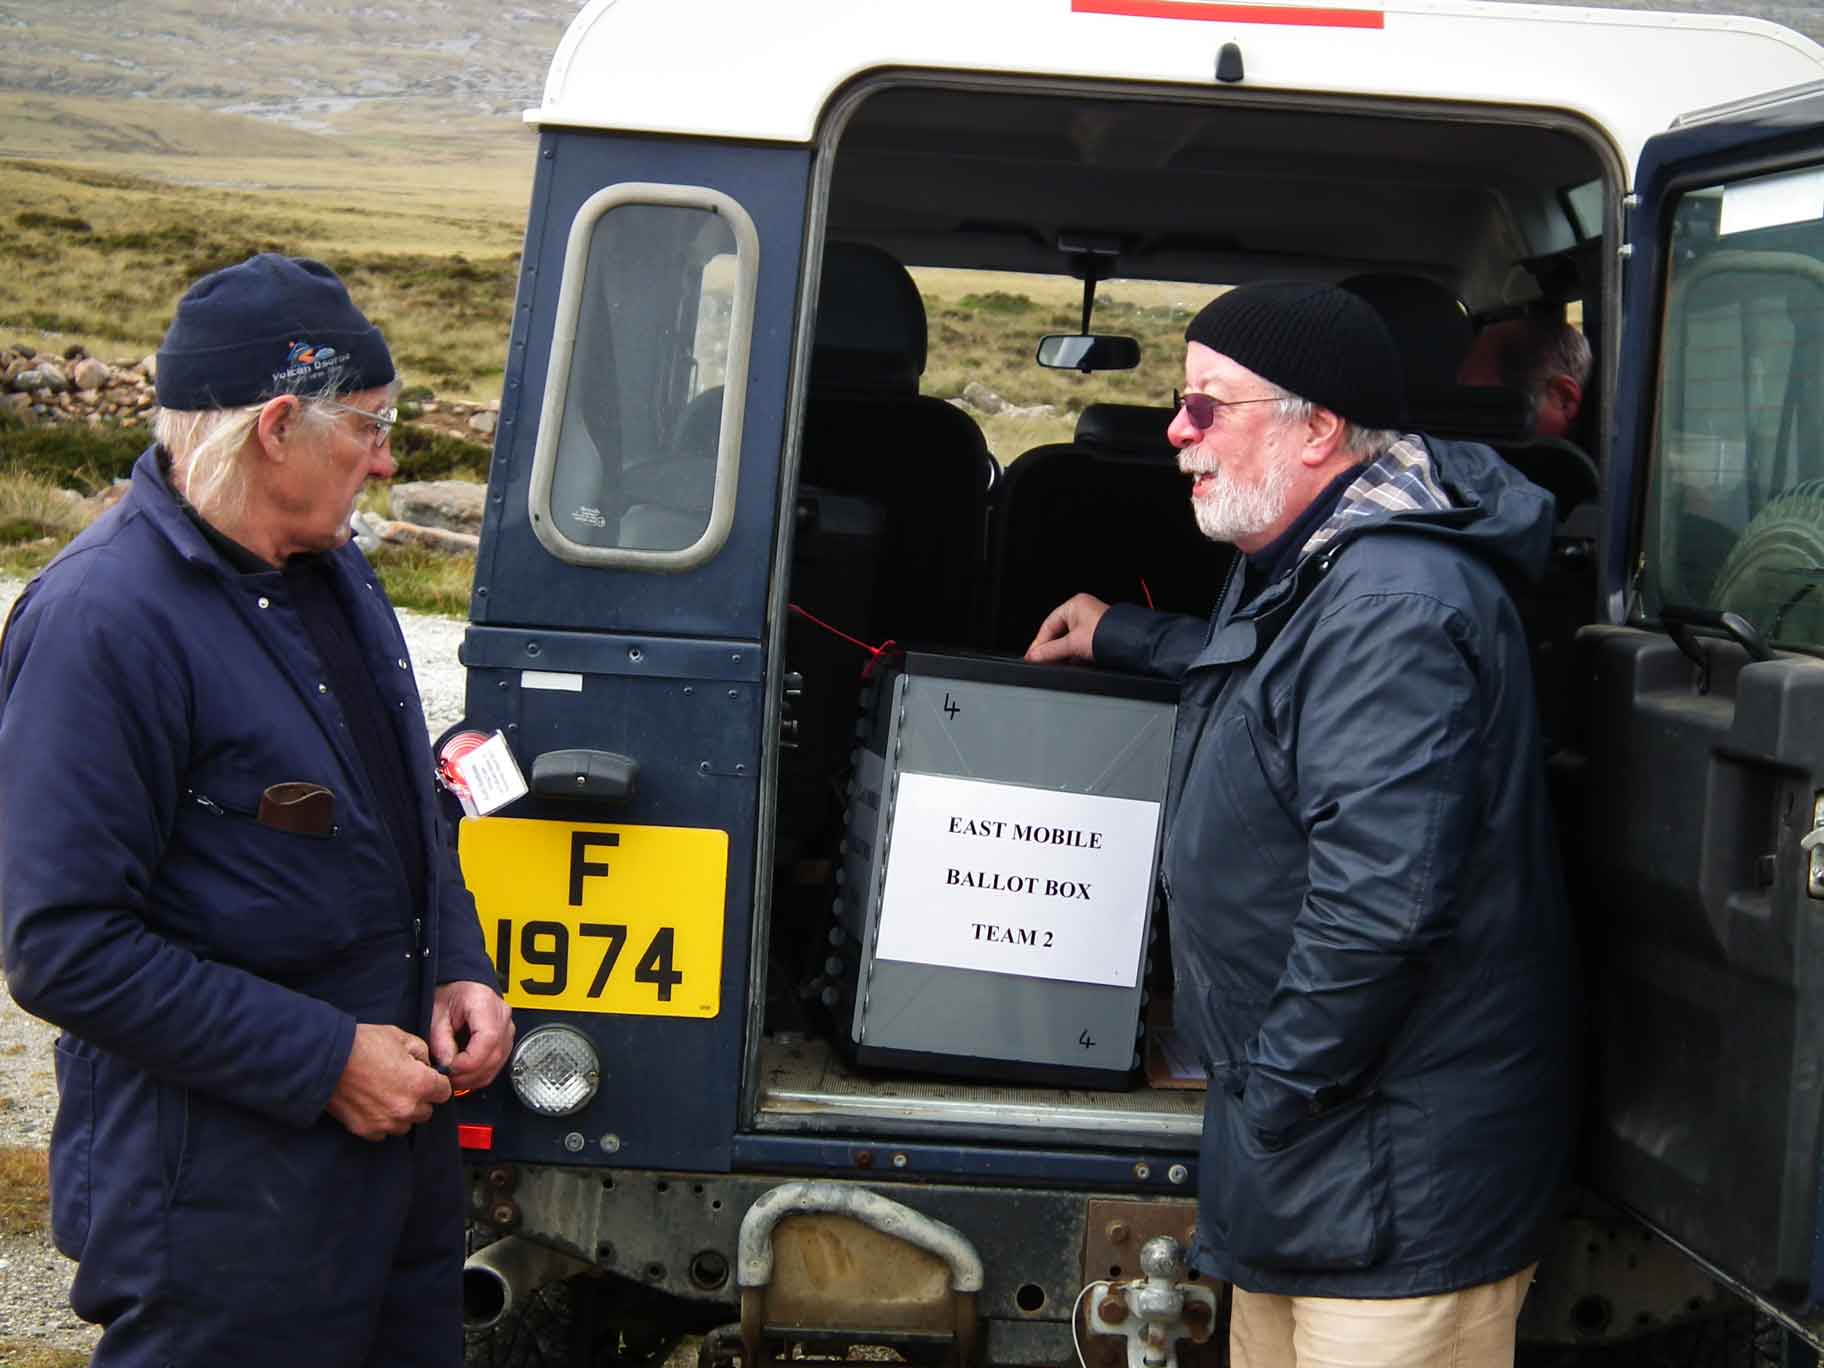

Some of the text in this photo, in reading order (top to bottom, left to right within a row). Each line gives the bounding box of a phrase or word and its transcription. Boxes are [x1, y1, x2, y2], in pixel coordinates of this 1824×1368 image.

[943, 692, 961, 721] 4
[949, 816, 1103, 849] EAST MOBILE
[568, 830, 620, 906] F
[946, 868, 1092, 900] BALLOT BOX
[971, 923, 1054, 948] TEAM 2
[496, 918, 683, 1002] 1974
[1079, 1028, 1096, 1049] 4
